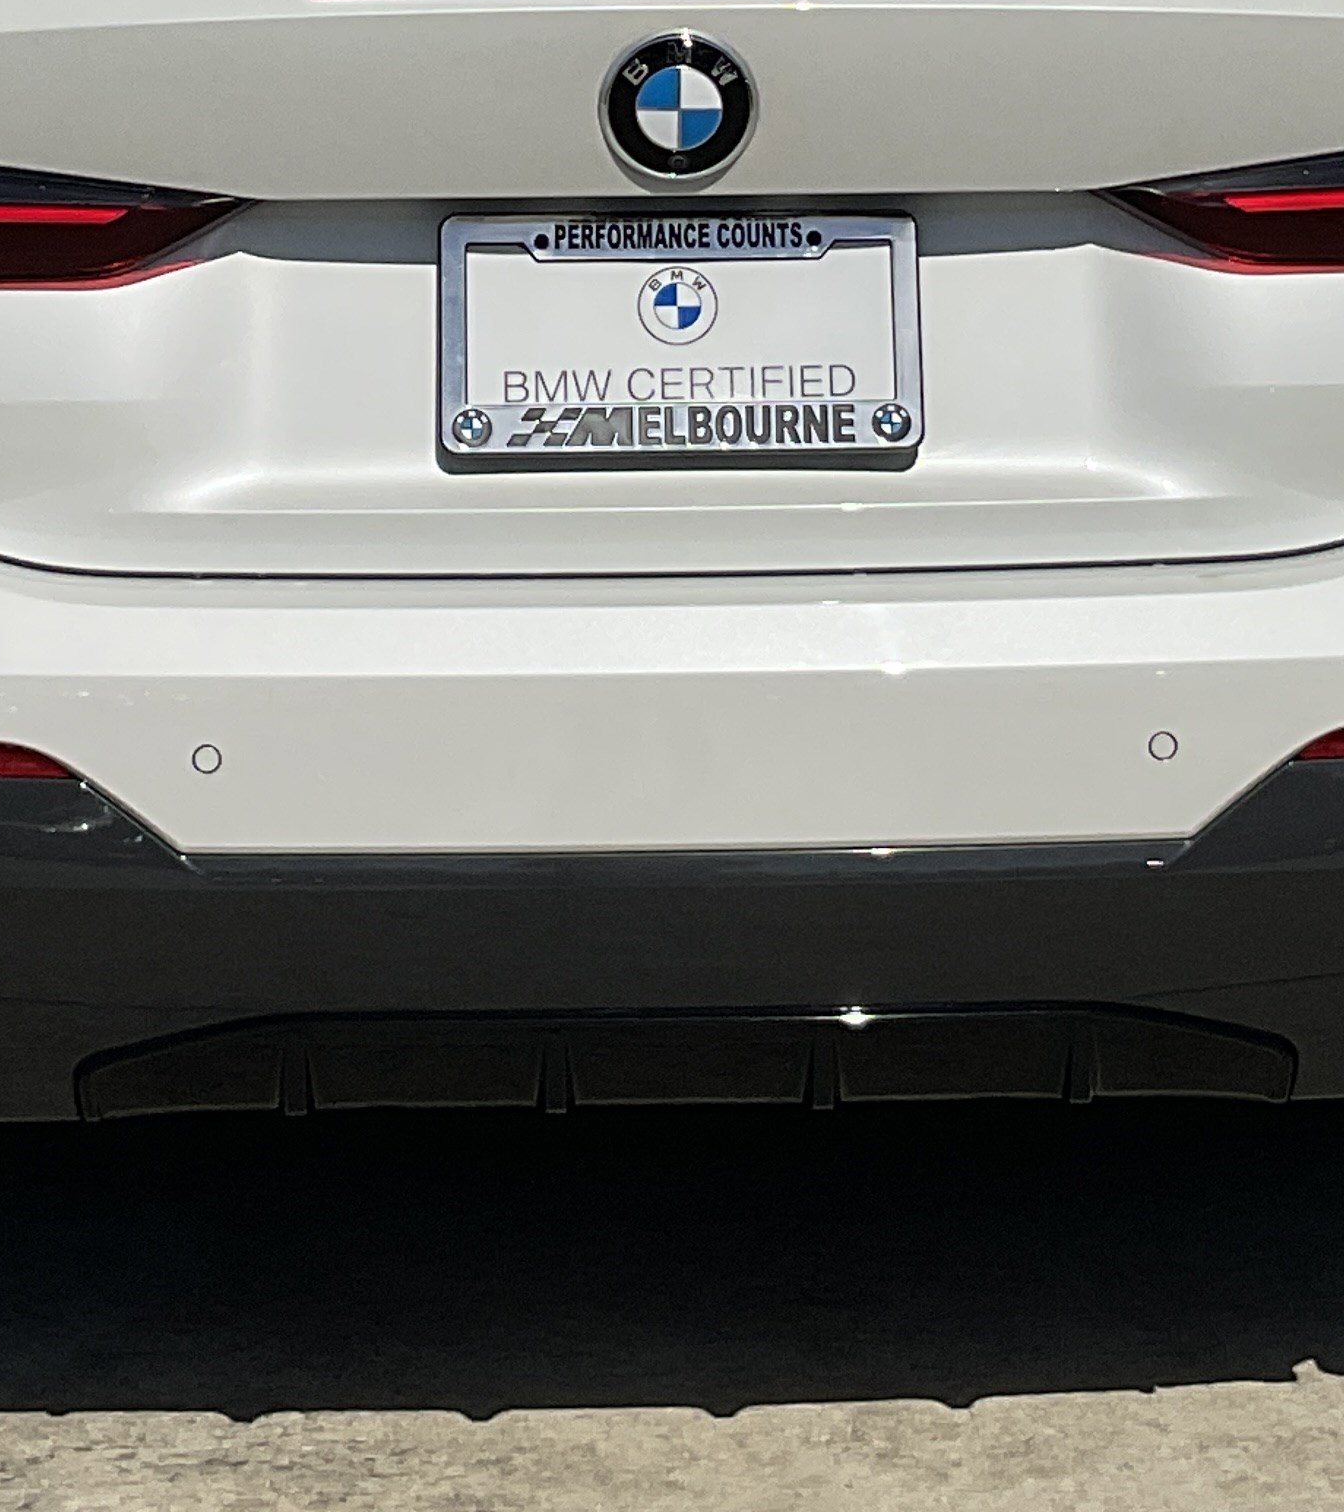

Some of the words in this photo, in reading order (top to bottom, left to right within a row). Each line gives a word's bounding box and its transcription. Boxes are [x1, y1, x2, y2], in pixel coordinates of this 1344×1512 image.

[622, 41, 738, 86] BMW
[554, 223, 711, 250] PERFORMANCE
[716, 222, 804, 249] COUNTS
[648, 270, 707, 292] BMW
[503, 369, 612, 403] BMW
[627, 364, 856, 400] CERTIFIED
[565, 404, 856, 447] MELBOURNE
